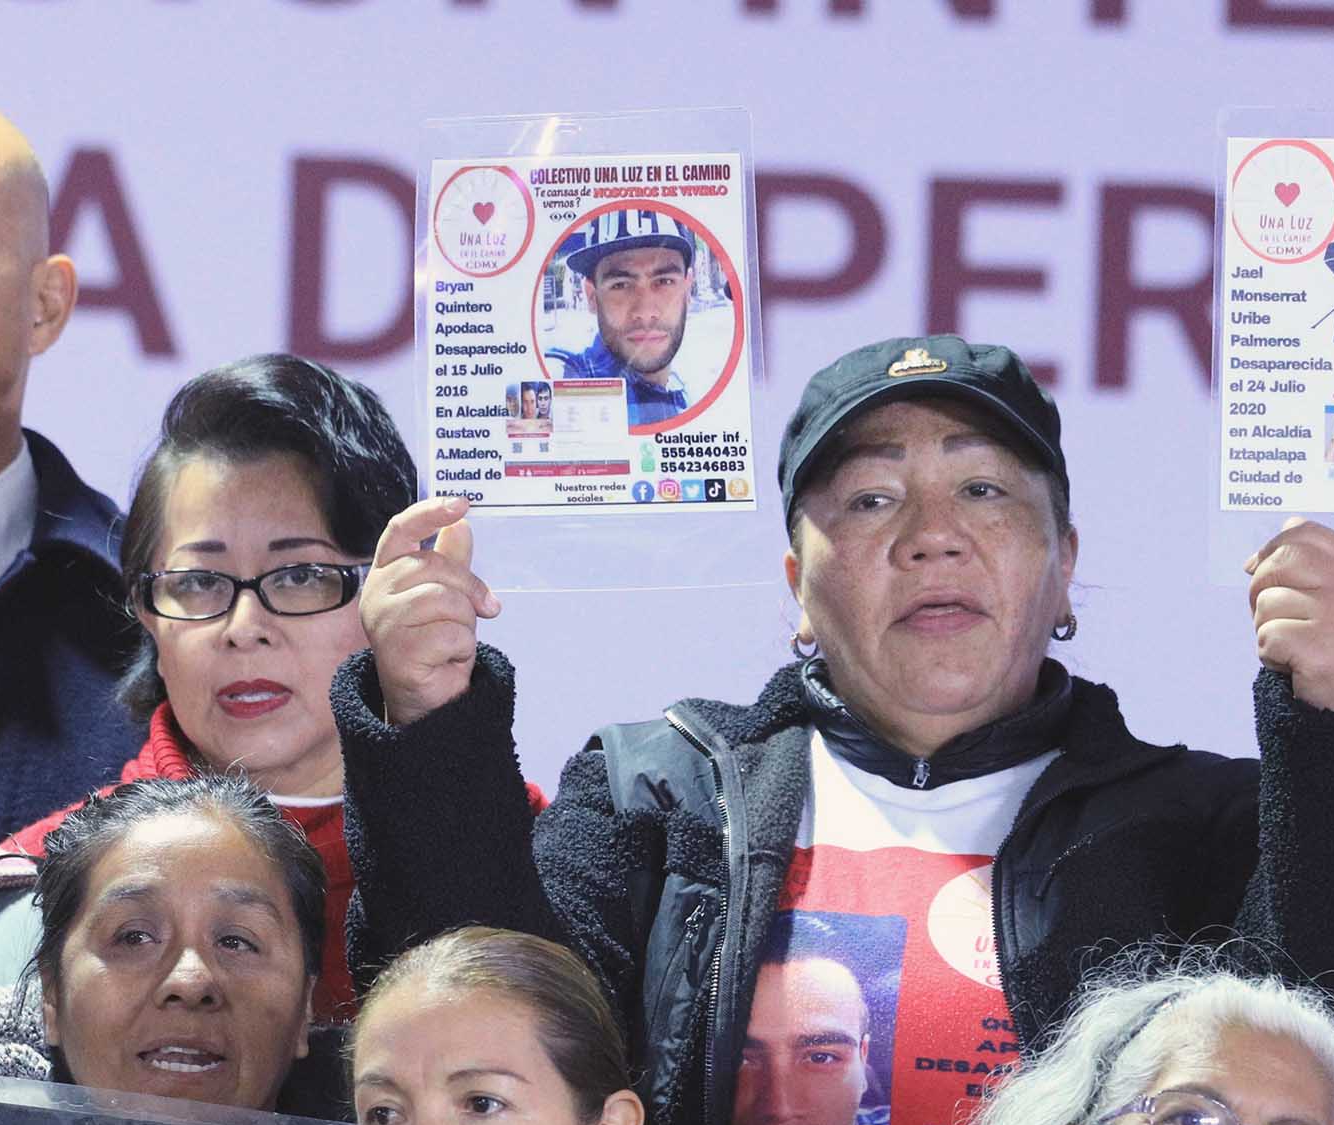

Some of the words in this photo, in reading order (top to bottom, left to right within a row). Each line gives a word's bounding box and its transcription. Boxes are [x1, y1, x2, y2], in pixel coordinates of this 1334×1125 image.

[530, 167, 591, 185] COLECTIVO
[594, 167, 618, 183] UNA
[622, 166, 643, 183] LUZ
[647, 165, 662, 182] EN
[666, 165, 679, 182] EL
[682, 164, 731, 182] CAMINO
[534, 186, 546, 197] Te
[546, 189, 579, 198] cansas
[580, 186, 592, 197] de
[543, 200, 575, 209] vernos
[1266, 246, 1303, 256] CDMX
[465, 261, 498, 269] CDMX
[1231, 266, 1264, 280] Jael
[435, 281, 474, 295] Bryan
[1231, 289, 1307, 303] Monserrat
[435, 301, 492, 315] Quintero
[1231, 311, 1271, 325] Uribe
[435, 321, 494, 336] Apodaca
[1230, 334, 1300, 349] Palmeros
[435, 342, 527, 357] Desaparecido
[435, 364, 448, 377] el
[452, 364, 468, 376] 15
[470, 363, 503, 376] Julio
[1230, 357, 1333, 373] Desaparecida
[435, 385, 468, 398] 2016
[1229, 379, 1244, 393] el
[1247, 379, 1266, 393] 24
[1269, 379, 1306, 394] Julio
[436, 406, 453, 418] En
[456, 404, 510, 418] Alcaldía
[1229, 402, 1266, 416] 2020
[435, 427, 491, 440] Gustavo
[655, 431, 718, 446] Cualquier
[1229, 427, 1248, 438] en
[1251, 424, 1312, 439] Alcaldía
[435, 448, 503, 461] A.Madero,
[661, 445, 747, 459] 5554840430
[1229, 447, 1307, 464] Iztapalapa
[660, 460, 745, 473] 5542346883
[436, 468, 481, 482] Ciudad
[485, 467, 502, 481] de
[1228, 470, 1281, 484] Ciudad
[1284, 470, 1303, 485] de
[555, 483, 598, 492] Nuestras
[599, 482, 626, 491] redes
[567, 493, 604, 503] sociales
[1228, 491, 1283, 507] México
